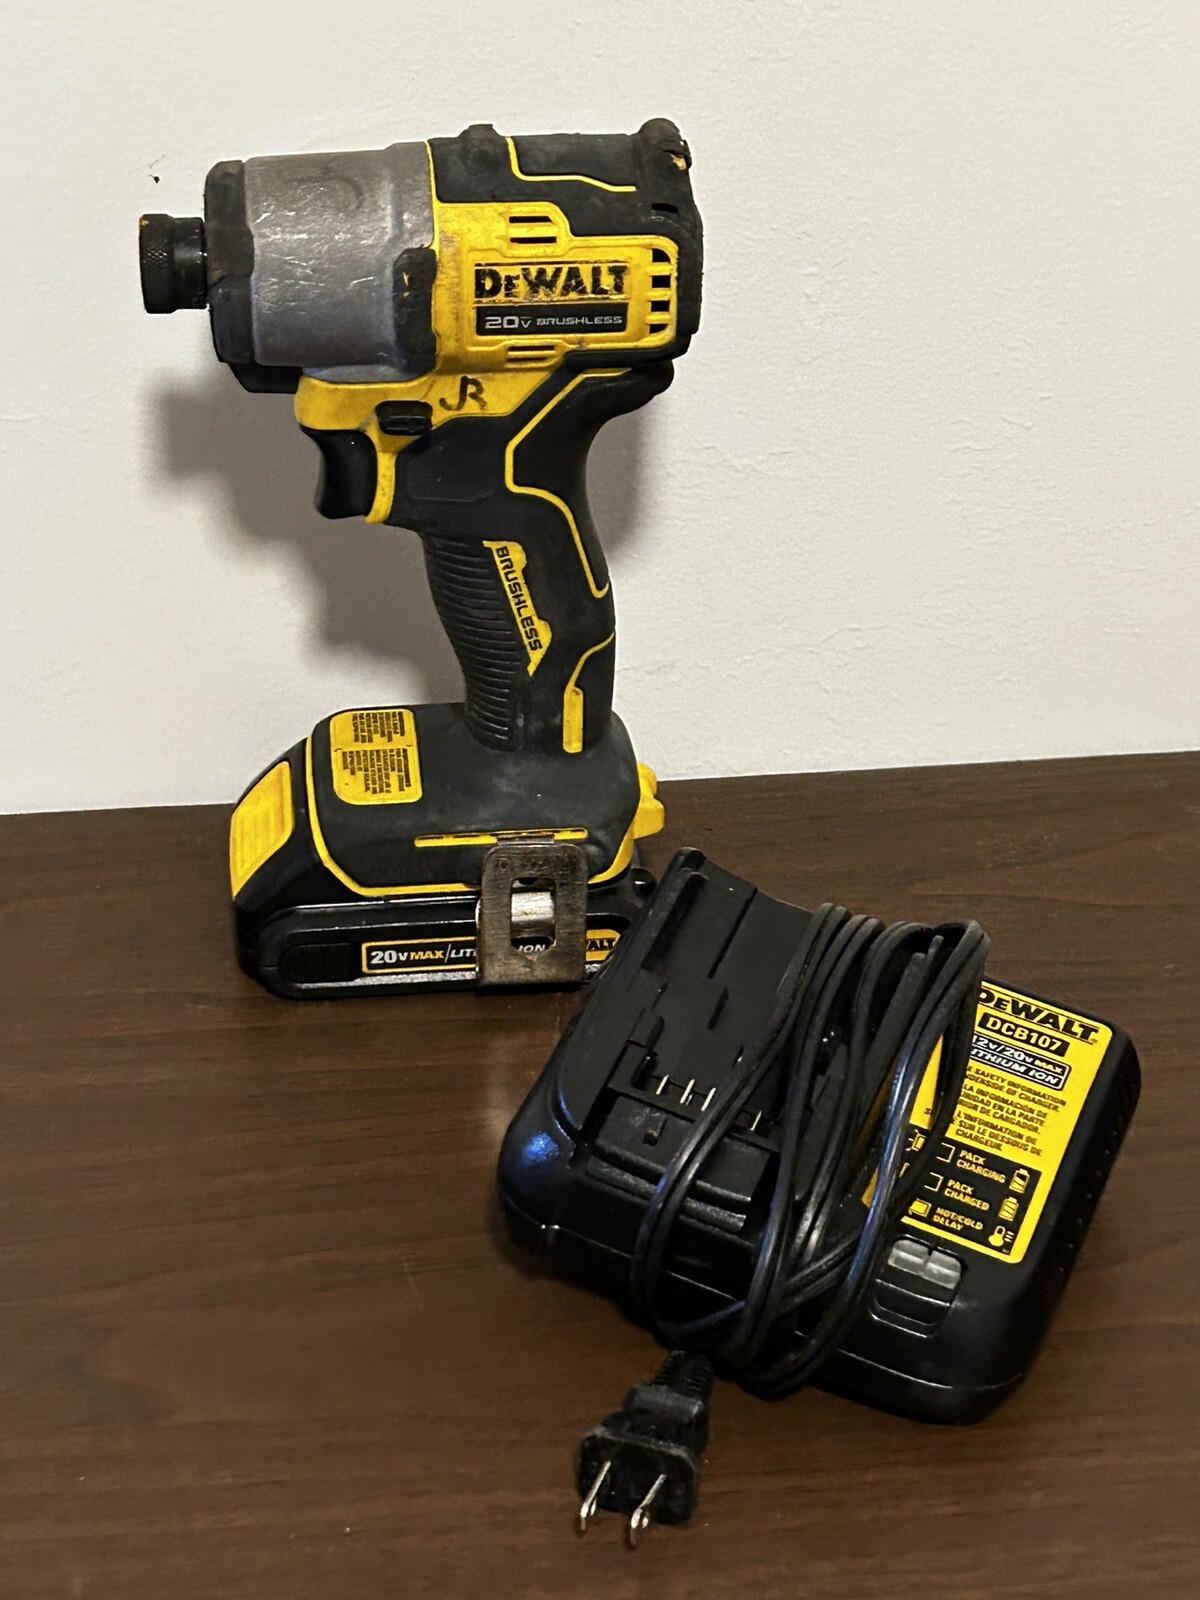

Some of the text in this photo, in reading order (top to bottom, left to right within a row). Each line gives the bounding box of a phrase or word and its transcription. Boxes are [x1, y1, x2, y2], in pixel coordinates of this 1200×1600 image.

[474, 265, 628, 299] DEWALT
[536, 315, 622, 326] BRUSHLESS
[438, 375, 488, 412] JR
[495, 545, 543, 652] BRUSHLESS
[977, 988, 1098, 1043] DEWALT
[985, 1016, 1062, 1052] DCB107
[970, 1049, 1059, 1085] ITHIUM ION
[1034, 1058, 1063, 1074] MAX
[974, 1067, 1066, 1106] SAFETY INFORMATION
[978, 1106, 990, 1116] DE
[991, 1102, 1004, 1112] EN
[1005, 1107, 1016, 1116] LA
[1017, 1111, 1044, 1126] PARTE
[1035, 1109, 1047, 1118] DE
[958, 1119, 976, 1131] SUR
[976, 1126, 986, 1136] LE
[987, 1131, 1029, 1151] DESSOUS
[1029, 1146, 1042, 1156] DE
[1024, 1135, 1037, 1145] DE
[959, 1149, 986, 1165] PACK
[956, 1158, 1006, 1183] CHARGING
[947, 1179, 974, 1194] PACK
[943, 1187, 990, 1211] CHARGED
[932, 1215, 964, 1231] DELAY
